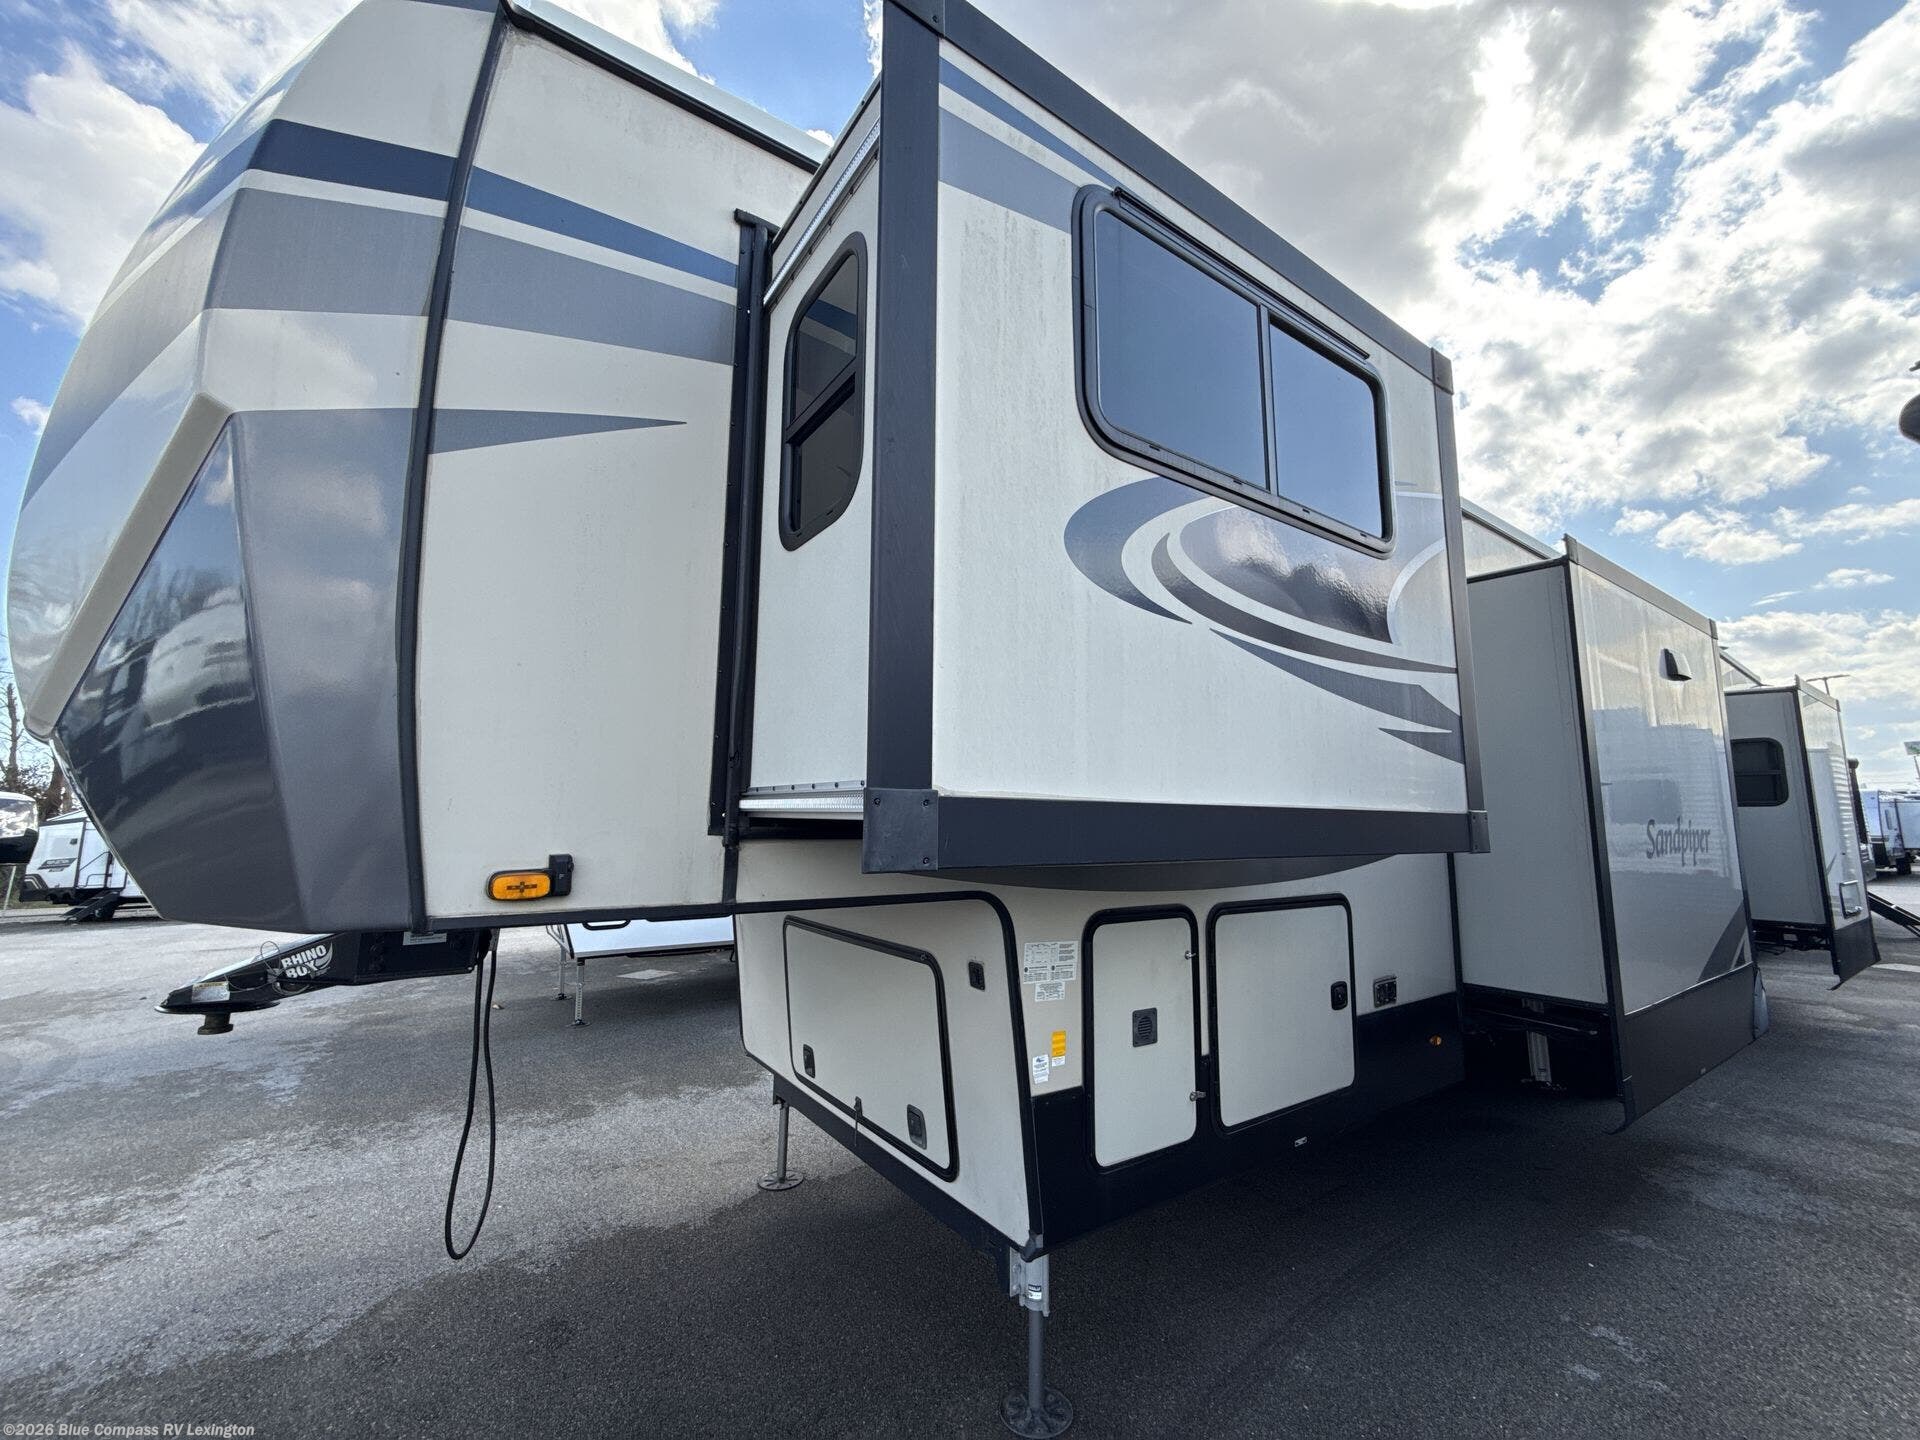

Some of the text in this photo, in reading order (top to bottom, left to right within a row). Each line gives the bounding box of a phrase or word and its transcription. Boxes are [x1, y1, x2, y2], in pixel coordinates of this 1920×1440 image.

[1646, 815, 1711, 868] Sandpiper
[281, 944, 327, 970] RHINO
[285, 959, 318, 979] BOX
